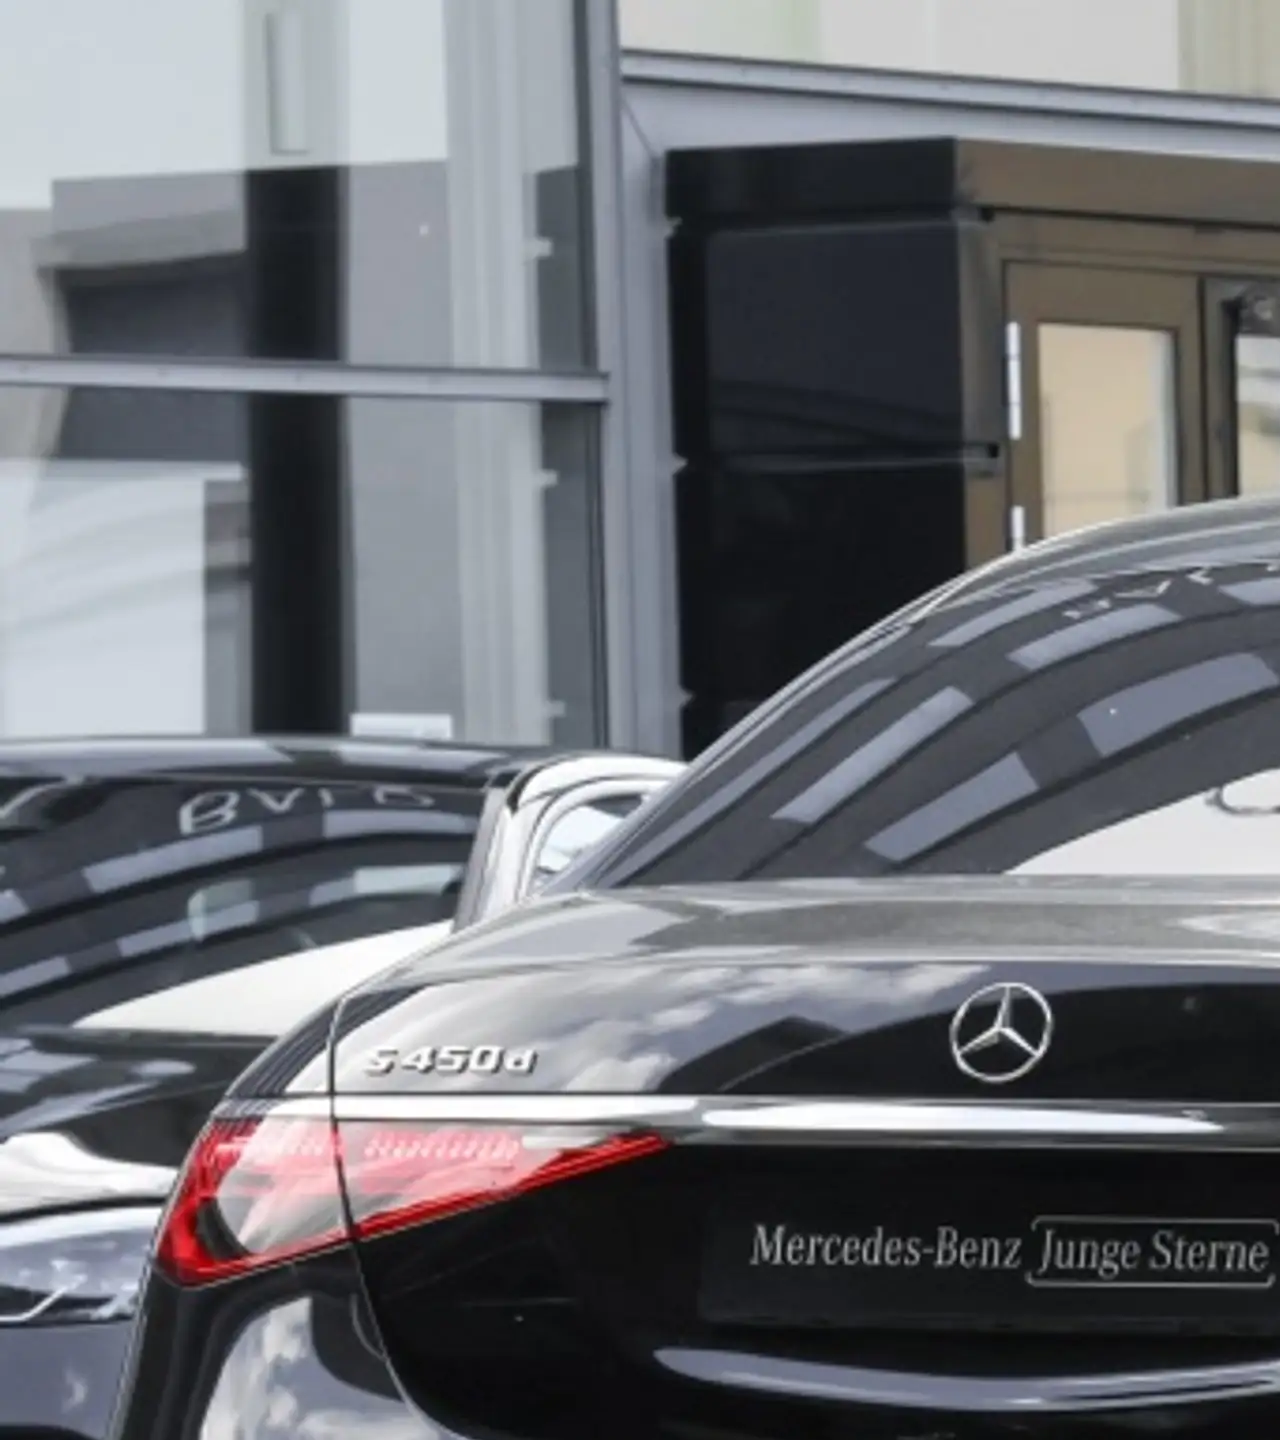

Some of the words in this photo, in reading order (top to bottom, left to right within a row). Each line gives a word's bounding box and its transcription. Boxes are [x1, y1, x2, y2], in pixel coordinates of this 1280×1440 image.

[750, 1224, 1022, 1268] Mercedes-Benz
[1037, 1230, 1141, 1279] Junge
[1148, 1230, 1269, 1272] Sterne
